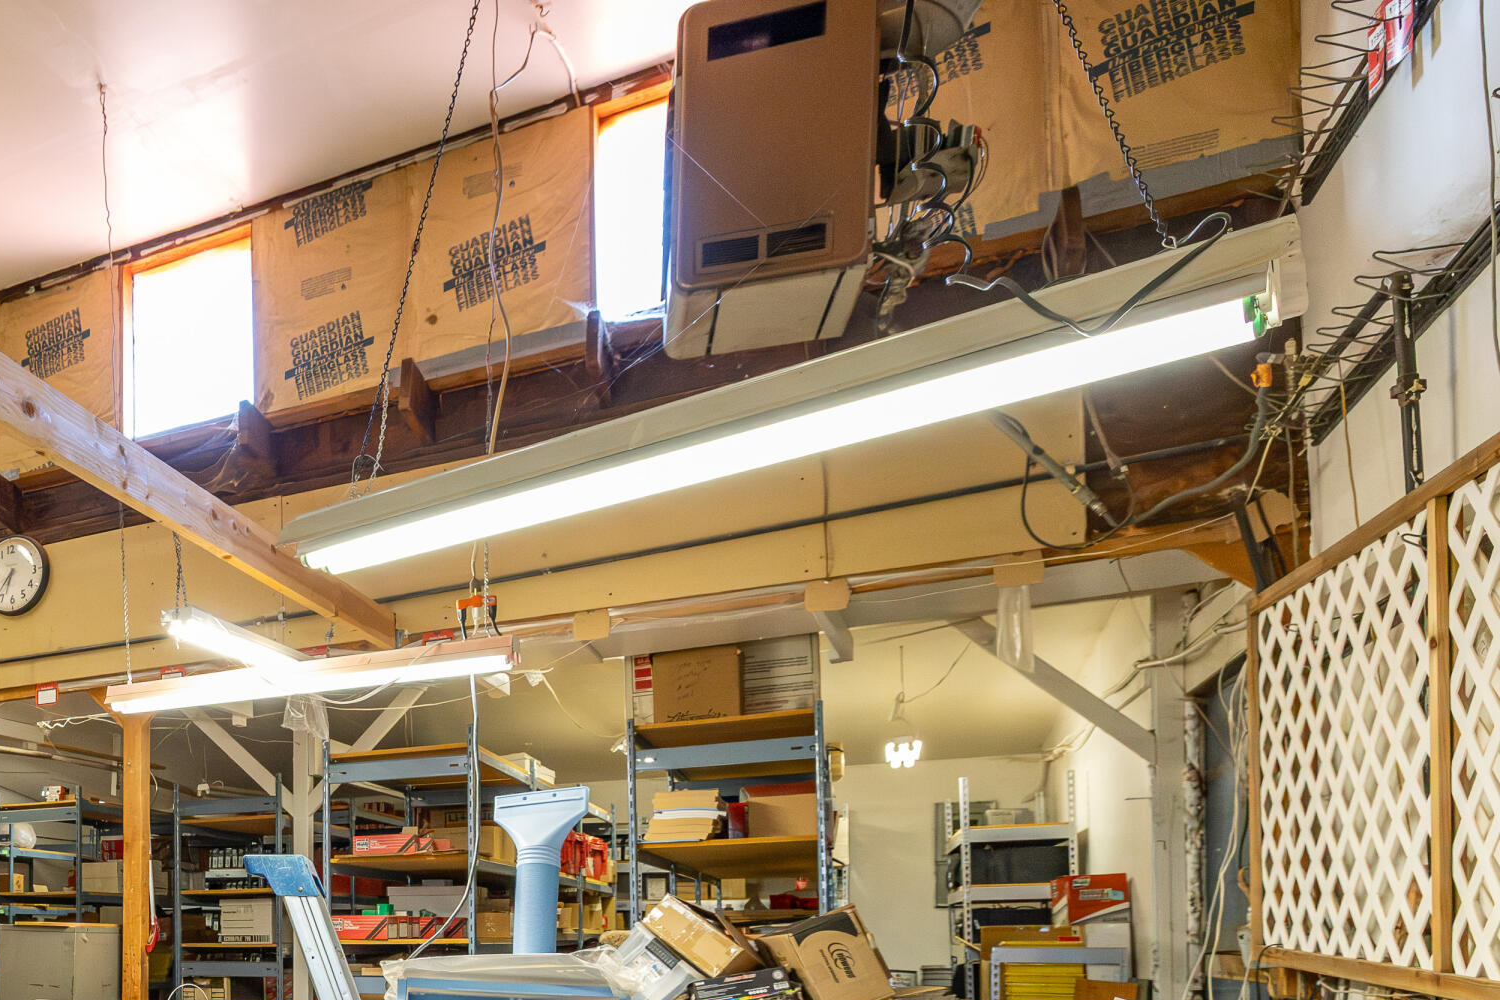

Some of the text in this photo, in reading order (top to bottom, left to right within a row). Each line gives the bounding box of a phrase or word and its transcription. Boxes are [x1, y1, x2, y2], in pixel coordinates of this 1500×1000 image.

[290, 310, 361, 348] GUARDIAN
[293, 332, 364, 367] GUARDIAN
[6, 544, 15, 555] 12
[32, 564, 37, 574] 3
[27, 579, 33, 588] 4
[0, 593, 5, 603] 7
[10, 594, 15, 604] 6
[20, 589, 26, 599] 5
